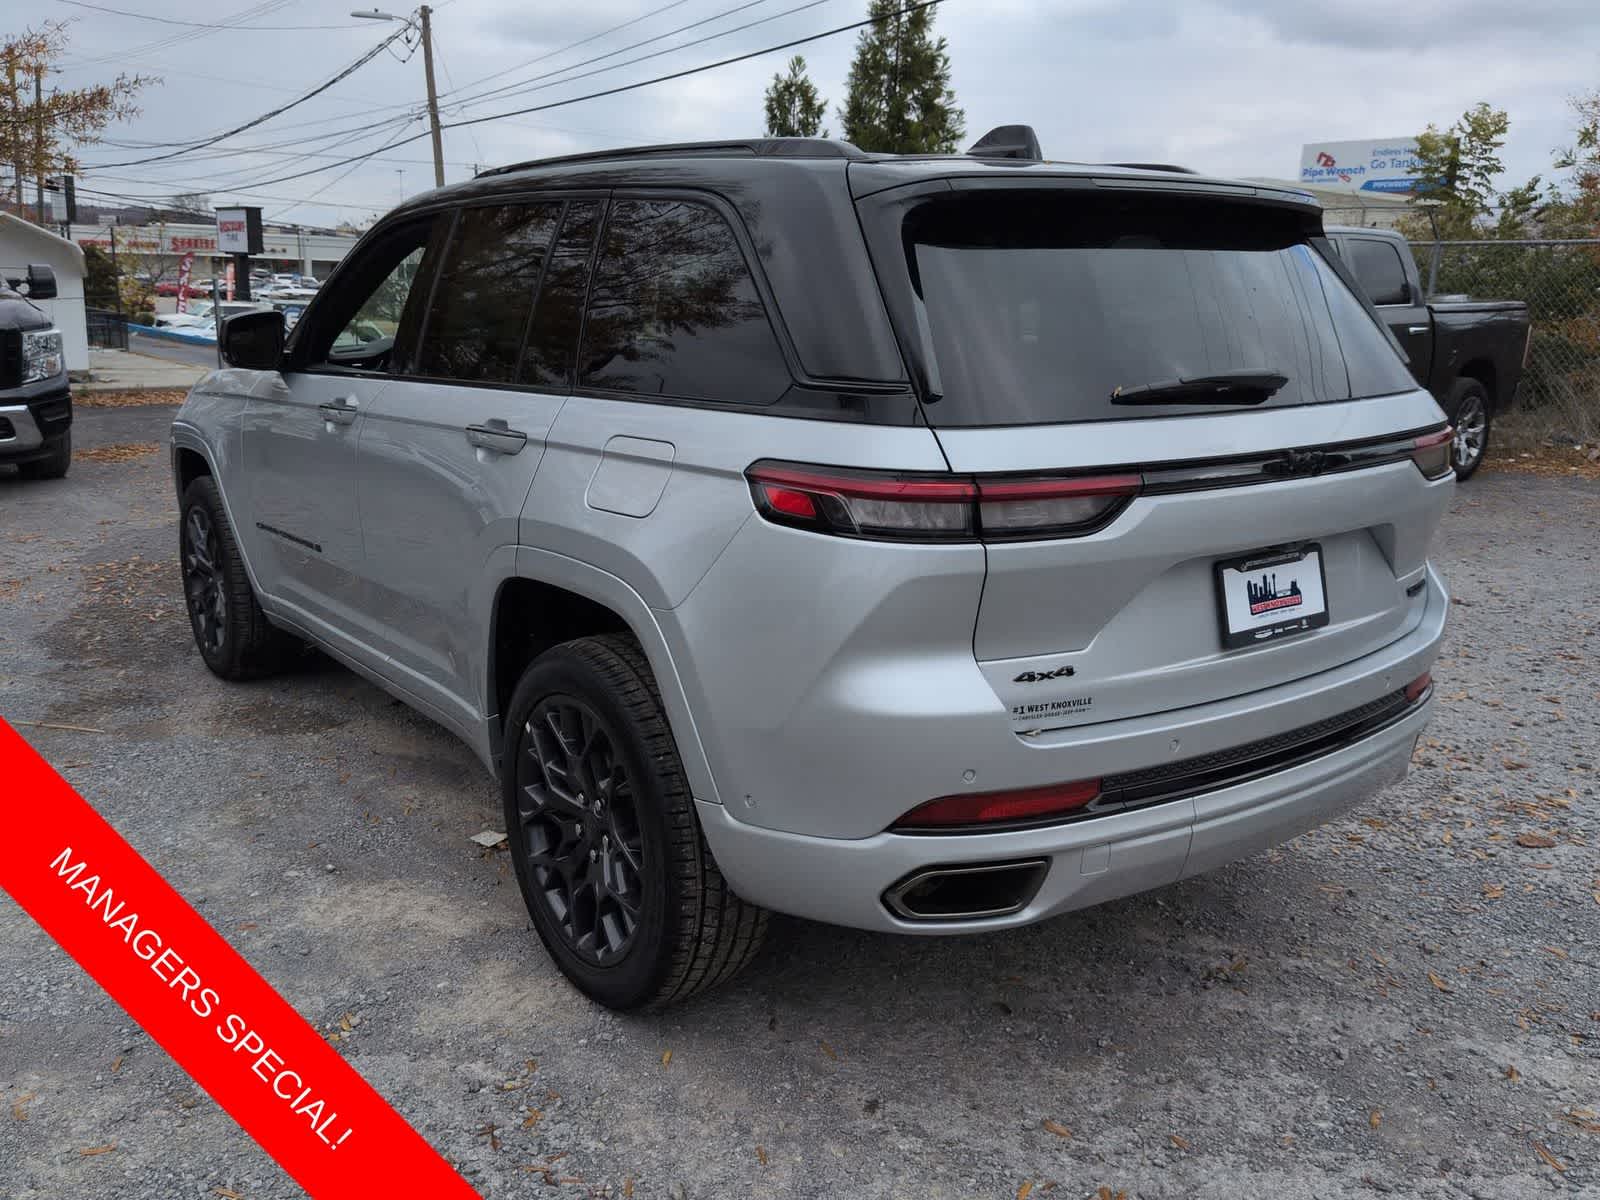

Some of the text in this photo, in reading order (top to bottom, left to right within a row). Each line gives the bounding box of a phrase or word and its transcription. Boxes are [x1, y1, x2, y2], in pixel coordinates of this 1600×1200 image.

[1302, 165, 1366, 178] Pipe Wrench
[1371, 159, 1386, 169] Go
[1013, 665, 1075, 683] 4x4
[1012, 697, 1093, 714] #1 WEST KNOXVILLE
